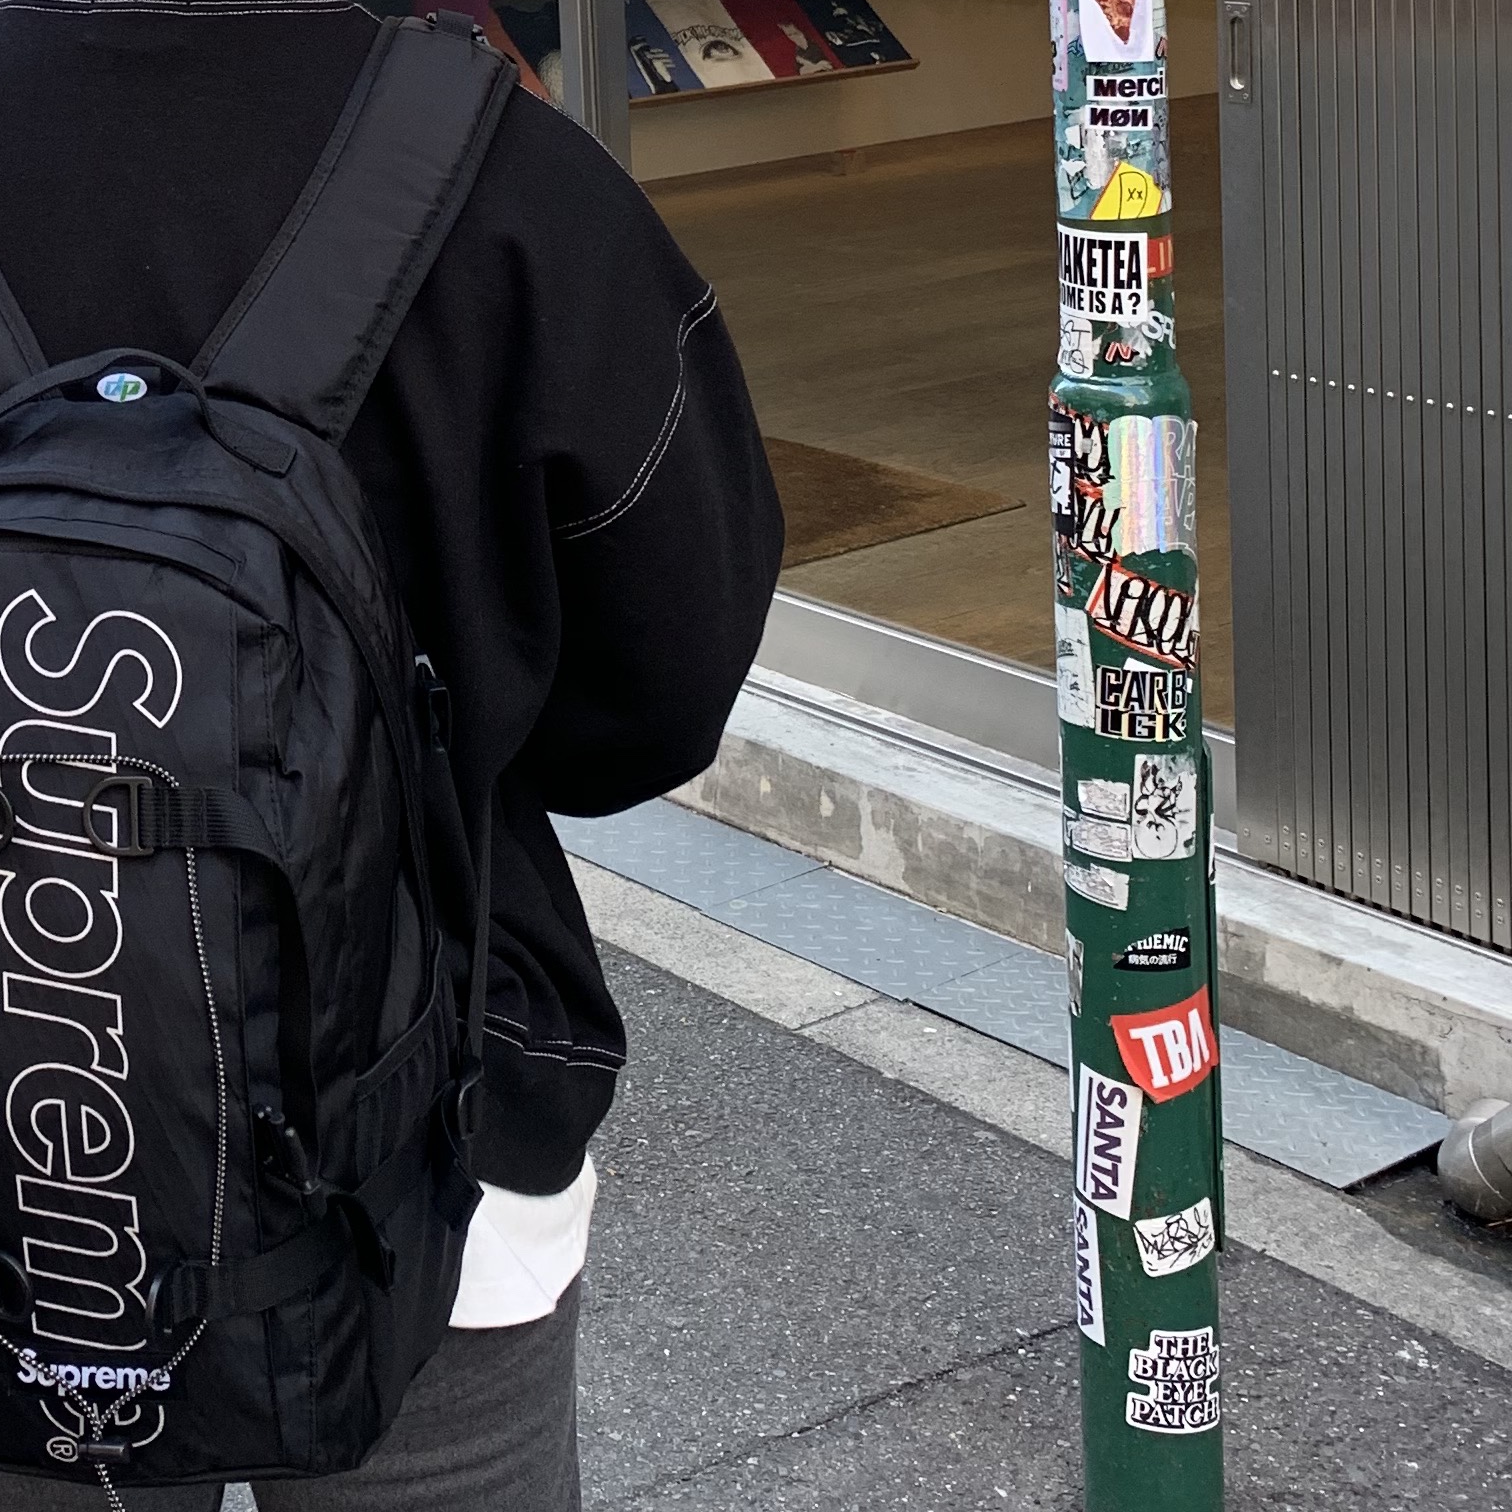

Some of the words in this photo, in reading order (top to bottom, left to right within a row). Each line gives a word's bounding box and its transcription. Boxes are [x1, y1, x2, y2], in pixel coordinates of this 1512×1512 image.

[1089, 289, 1106, 314] IS
[1110, 291, 1124, 316] A
[1090, 1081, 1129, 1202] SANTA
[1075, 1206, 1094, 1326] SANTA
[1154, 1333, 1210, 1359] THE
[16, 1347, 171, 1397] Supreme
[1134, 1349, 1218, 1381] BLACK
[1154, 1379, 1208, 1405] EYE
[1130, 1397, 1219, 1429] PATCH
